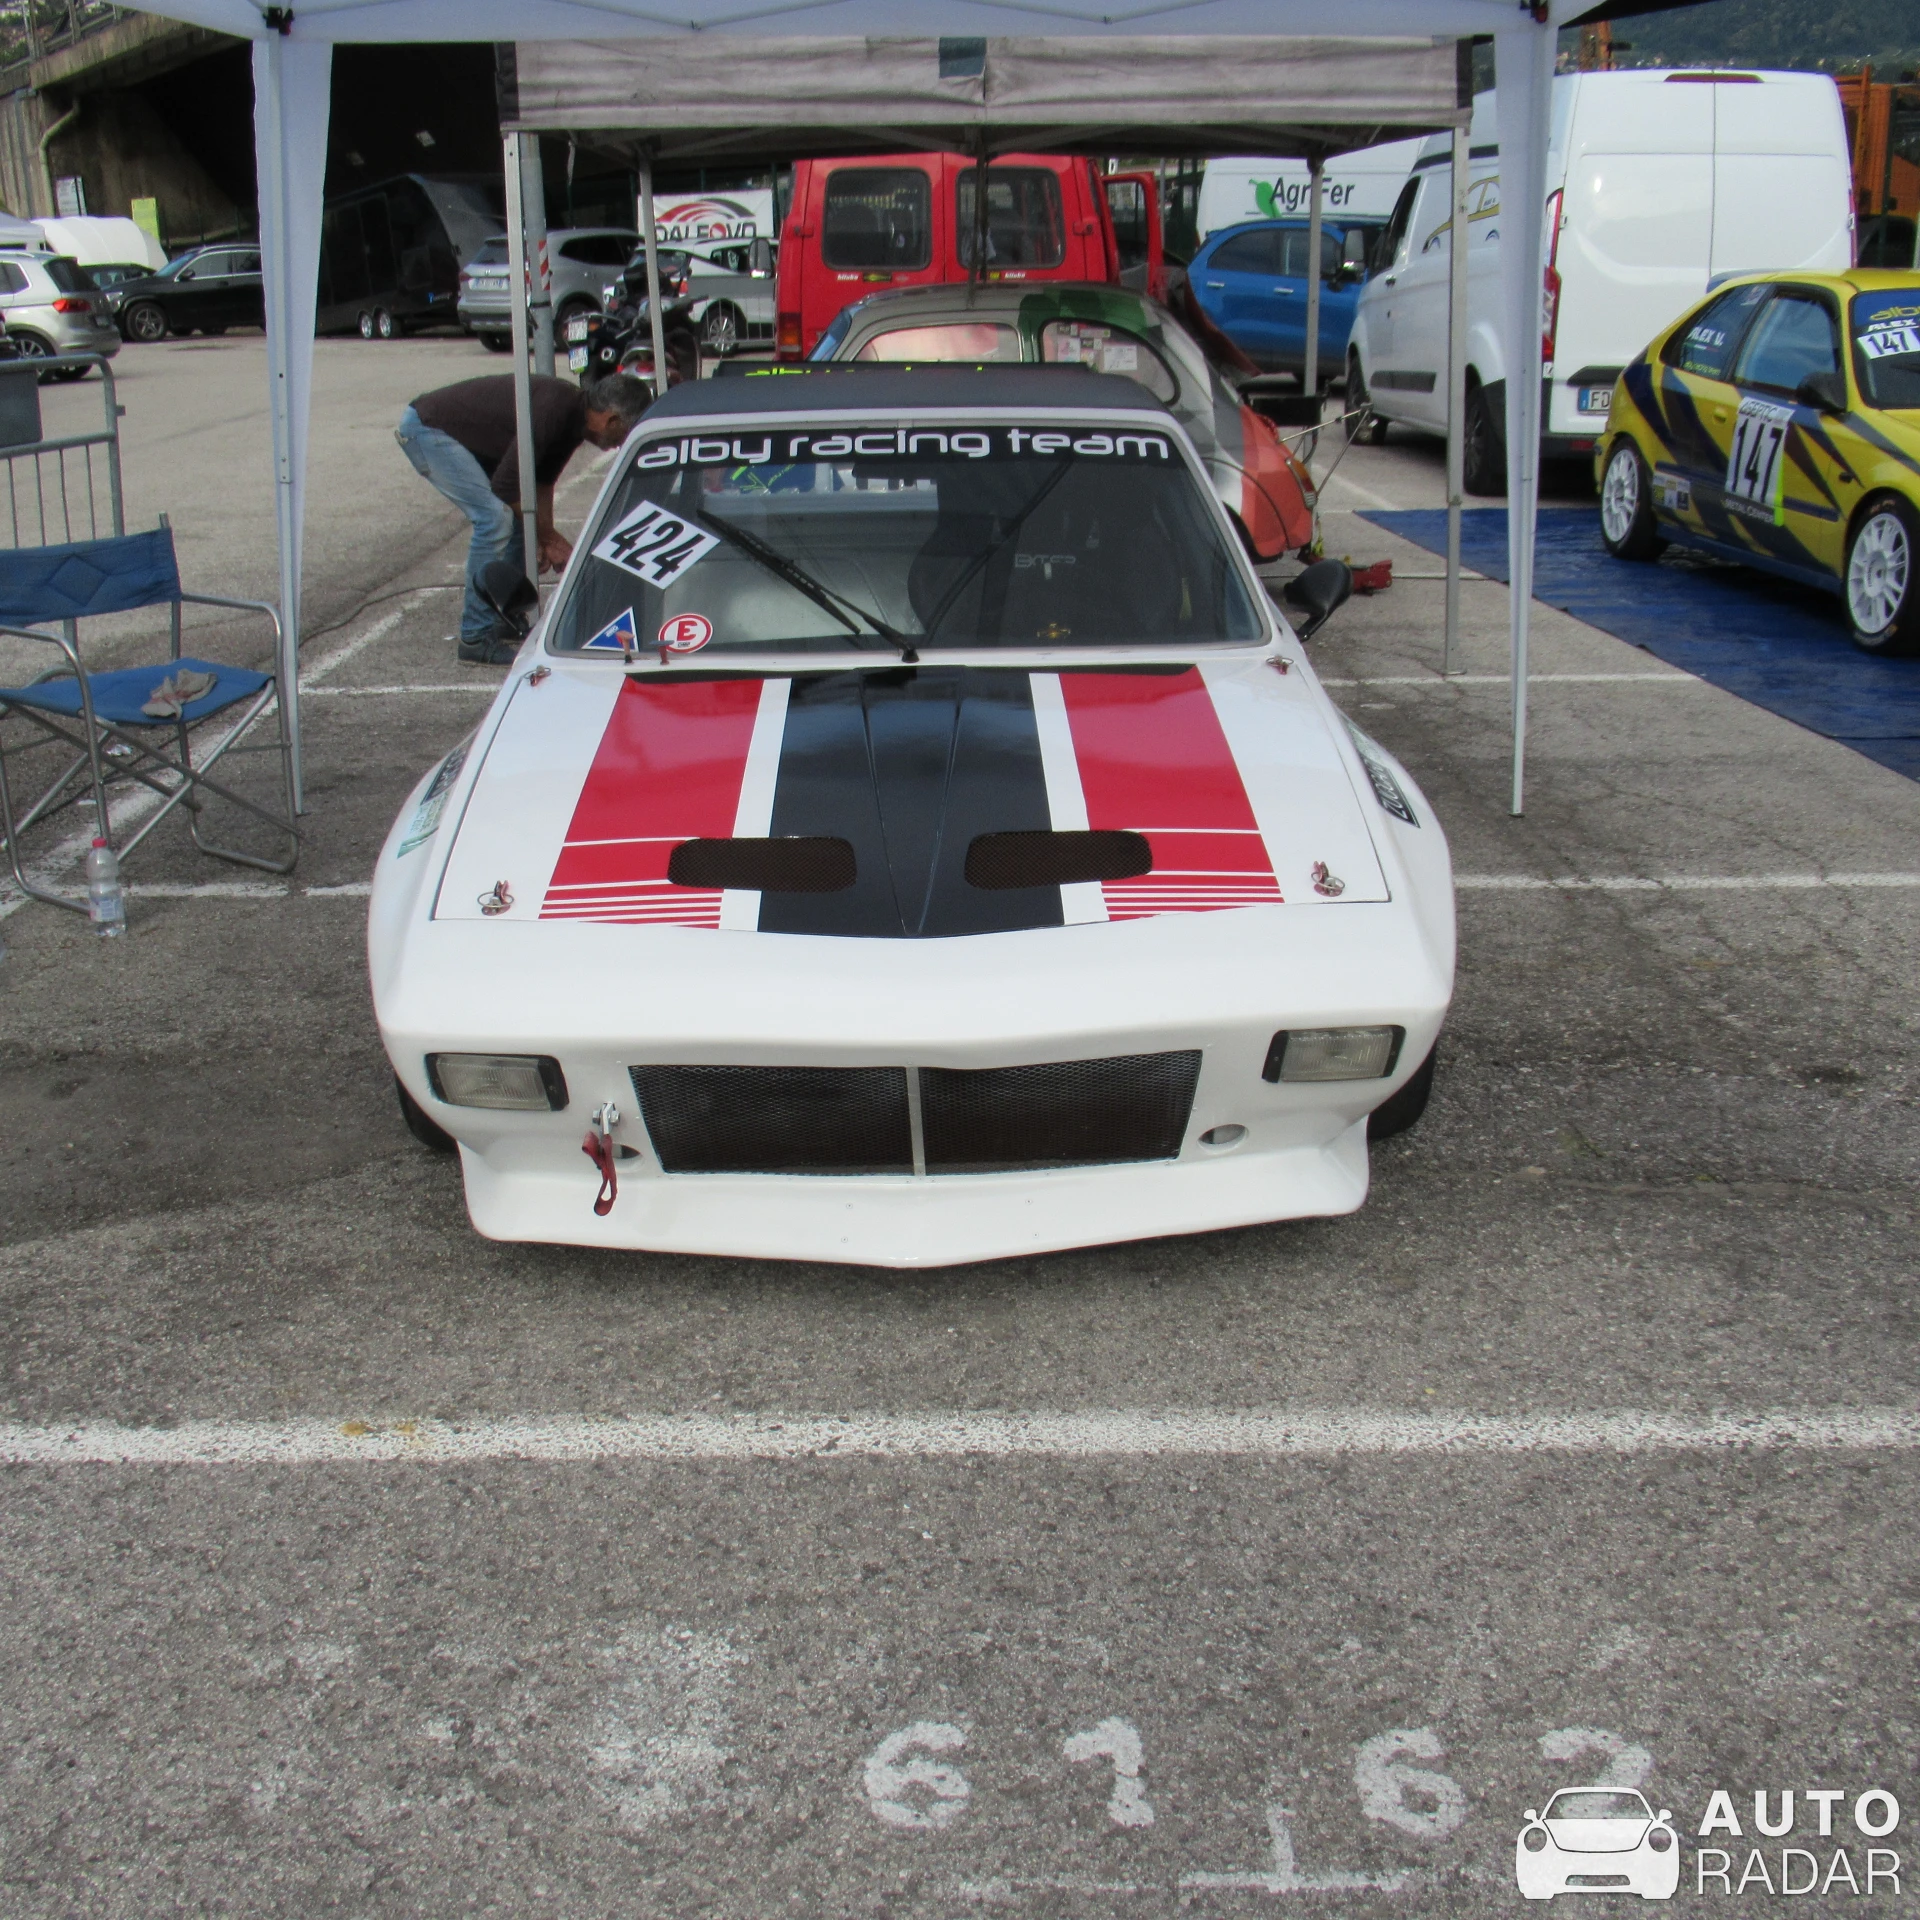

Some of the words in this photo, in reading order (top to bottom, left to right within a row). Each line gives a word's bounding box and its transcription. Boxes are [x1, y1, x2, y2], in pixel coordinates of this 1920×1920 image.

[1686, 326, 1716, 343] ALEX
[1868, 331, 1910, 355] 147
[637, 438, 772, 469] alby
[789, 429, 991, 459] racing
[1007, 428, 1169, 460] team
[1732, 416, 1785, 504] 147
[610, 510, 706, 582] 424
[676, 620, 698, 642] E
